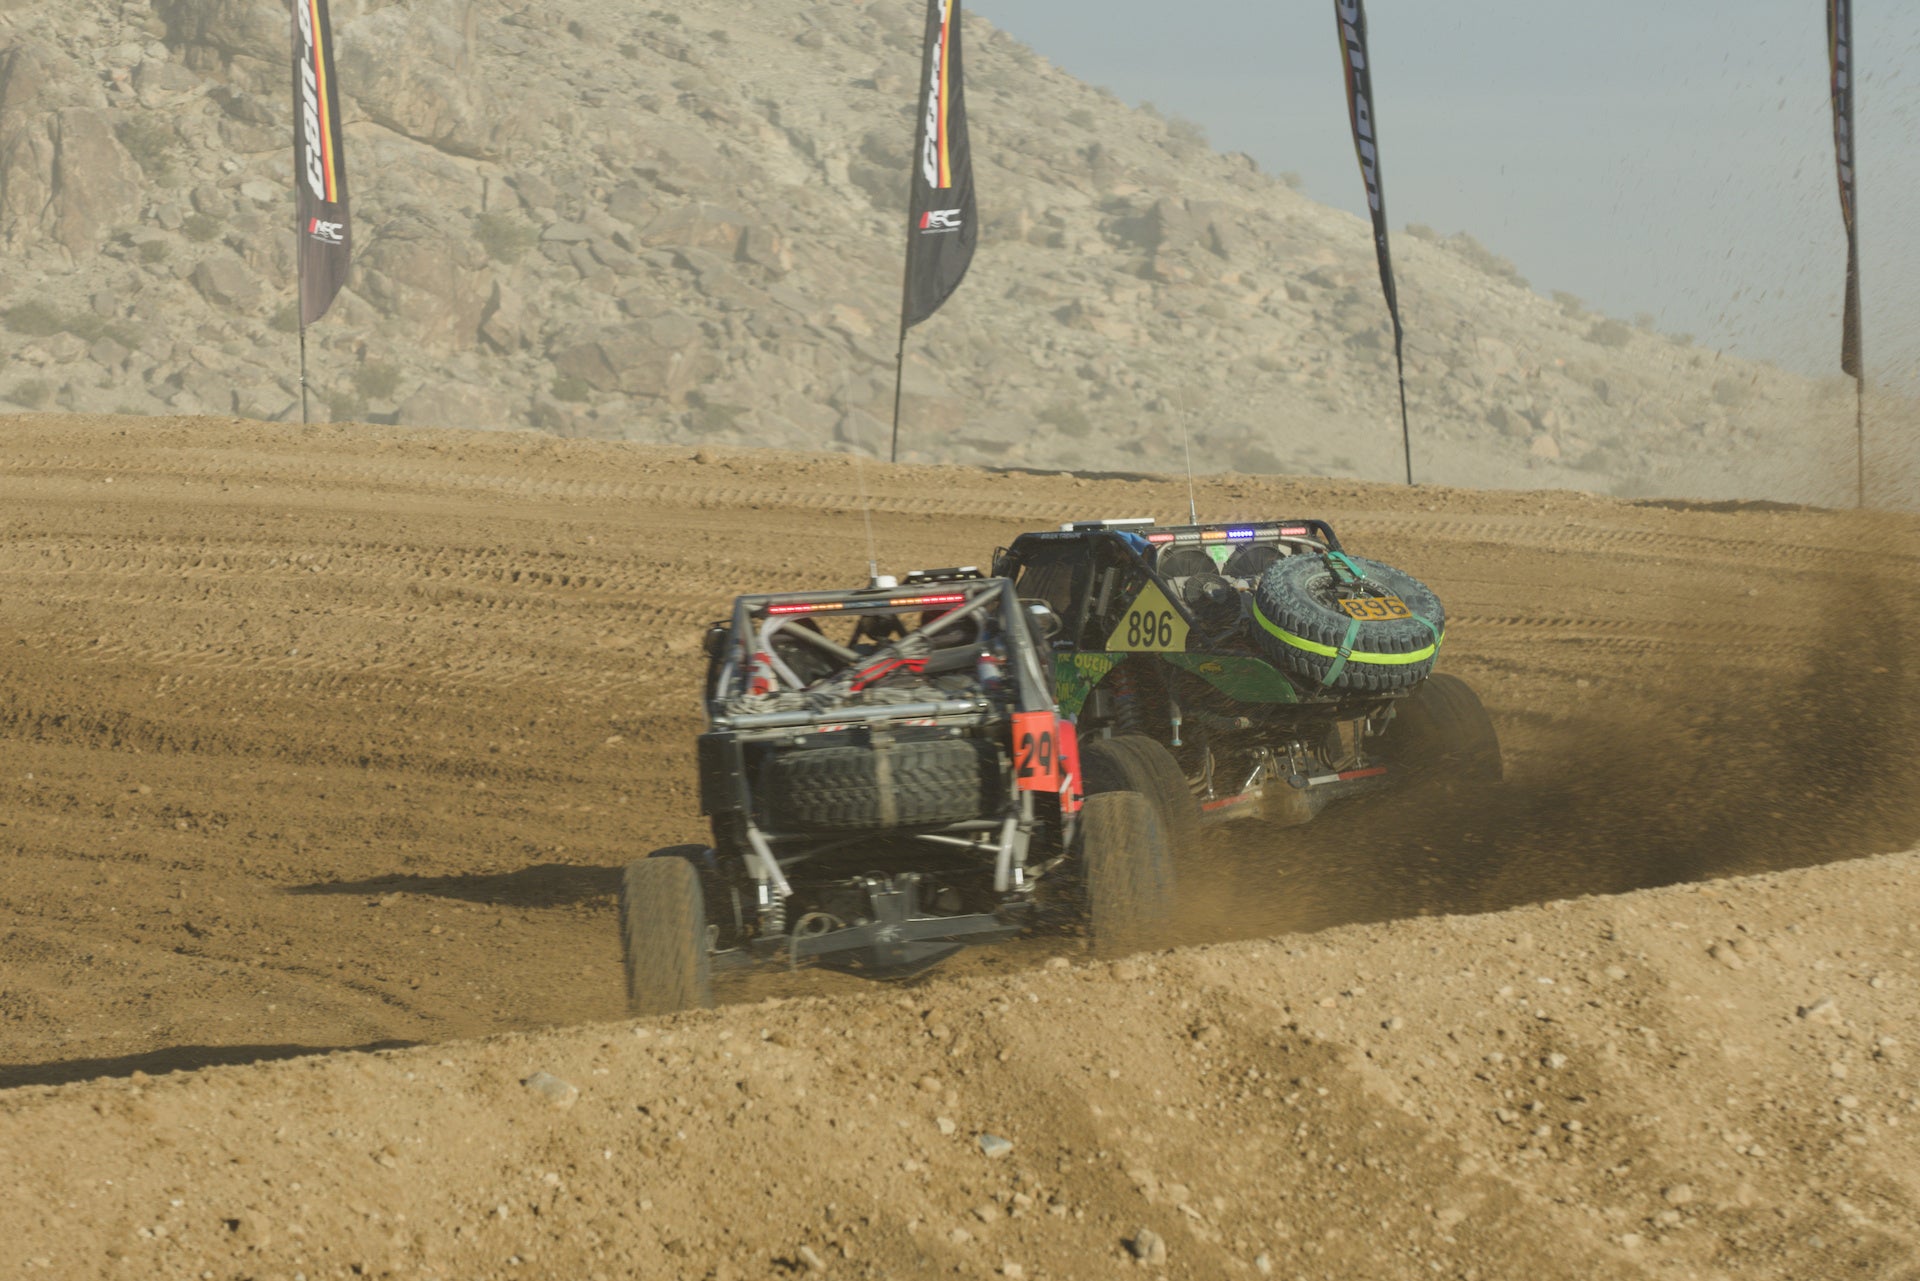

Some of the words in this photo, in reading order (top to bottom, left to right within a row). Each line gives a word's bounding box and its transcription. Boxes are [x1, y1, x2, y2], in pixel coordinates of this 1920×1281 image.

[1345, 598, 1408, 617] 896
[1127, 610, 1173, 648] 896
[1017, 731, 1052, 777] 29
